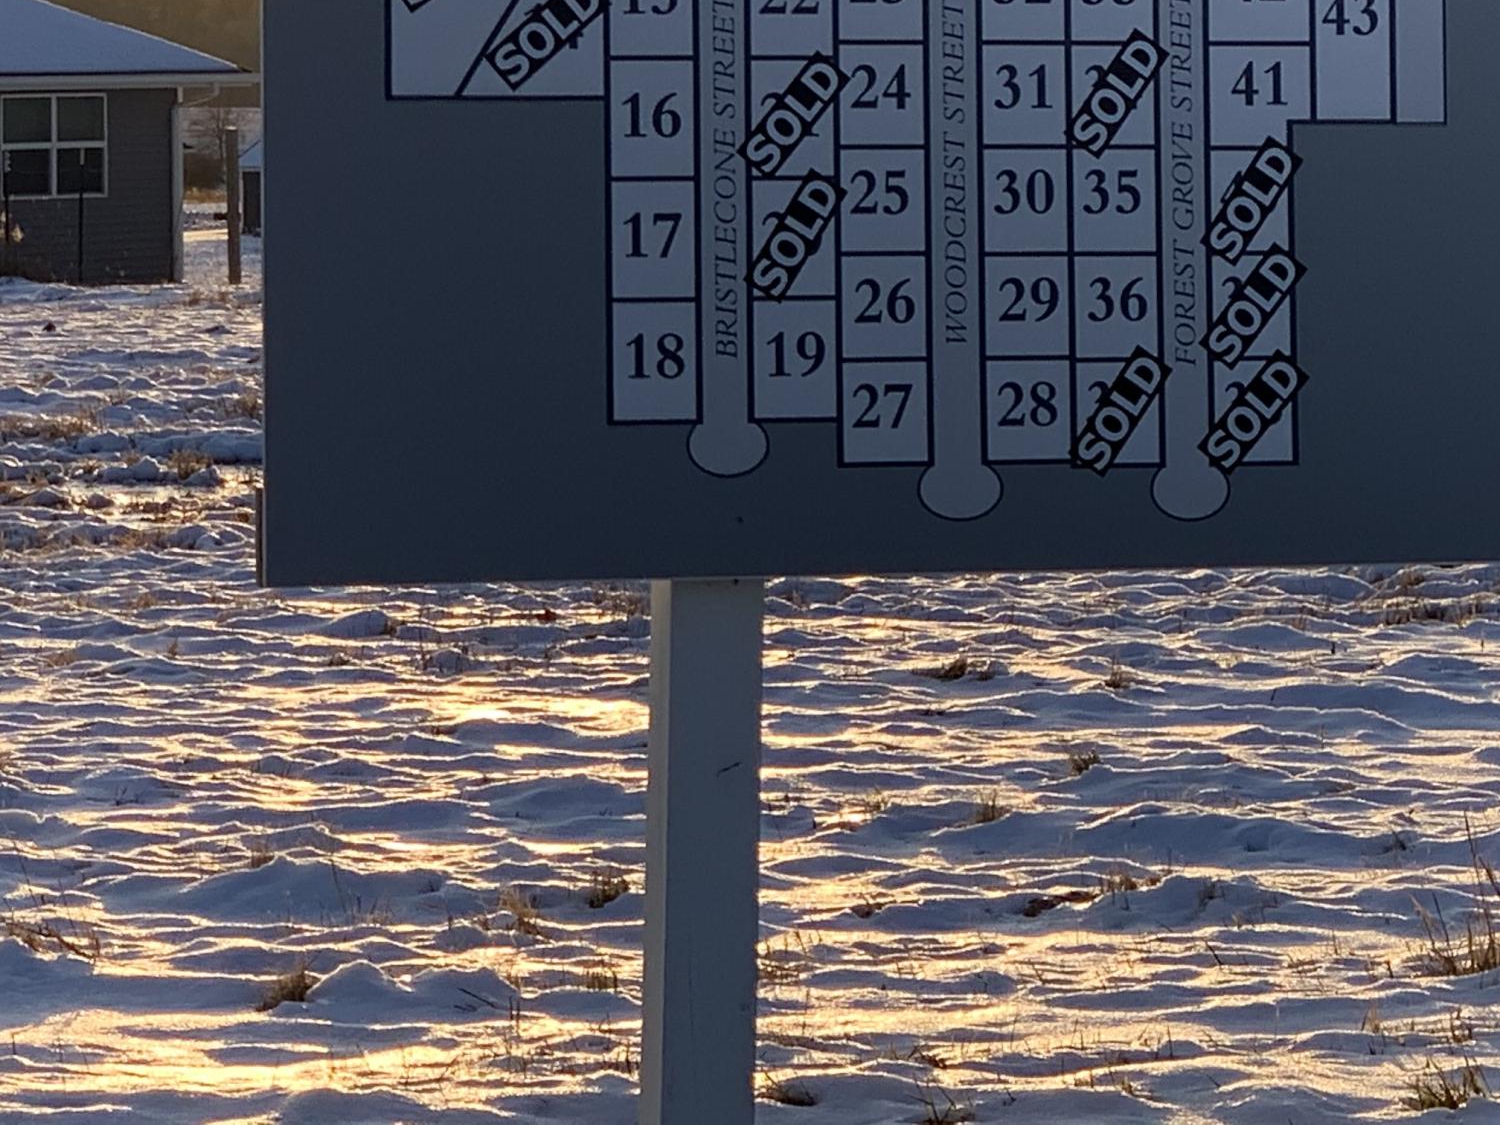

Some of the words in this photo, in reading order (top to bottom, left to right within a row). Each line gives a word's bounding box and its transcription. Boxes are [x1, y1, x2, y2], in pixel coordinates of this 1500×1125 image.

[850, 63, 912, 110] 24
[994, 63, 1054, 110] 31
[1073, 40, 1159, 152] SOLD
[1231, 61, 1288, 106] 41
[622, 92, 682, 139] 16
[746, 62, 839, 172] SOLD
[850, 170, 909, 215] 25
[995, 169, 1055, 214] 30
[1083, 169, 1141, 214] 35
[1171, 122, 1195, 231] GROVE
[1210, 147, 1292, 260] SOLD
[623, 212, 683, 259] 17
[714, 127, 738, 359] BRISTLECONE
[753, 179, 836, 297] SOLD
[943, 132, 968, 347] WOODCREST
[855, 278, 915, 324] 26
[998, 277, 1059, 322] 29
[1087, 277, 1148, 322] 36
[1173, 239, 1197, 366] FOREST
[1209, 254, 1296, 363] SOLD
[625, 332, 685, 378] 18
[766, 331, 825, 376] 19
[852, 384, 913, 430] 27
[996, 382, 1058, 428] 28
[1078, 357, 1161, 471] SOLD
[1207, 362, 1298, 468] SOLD
